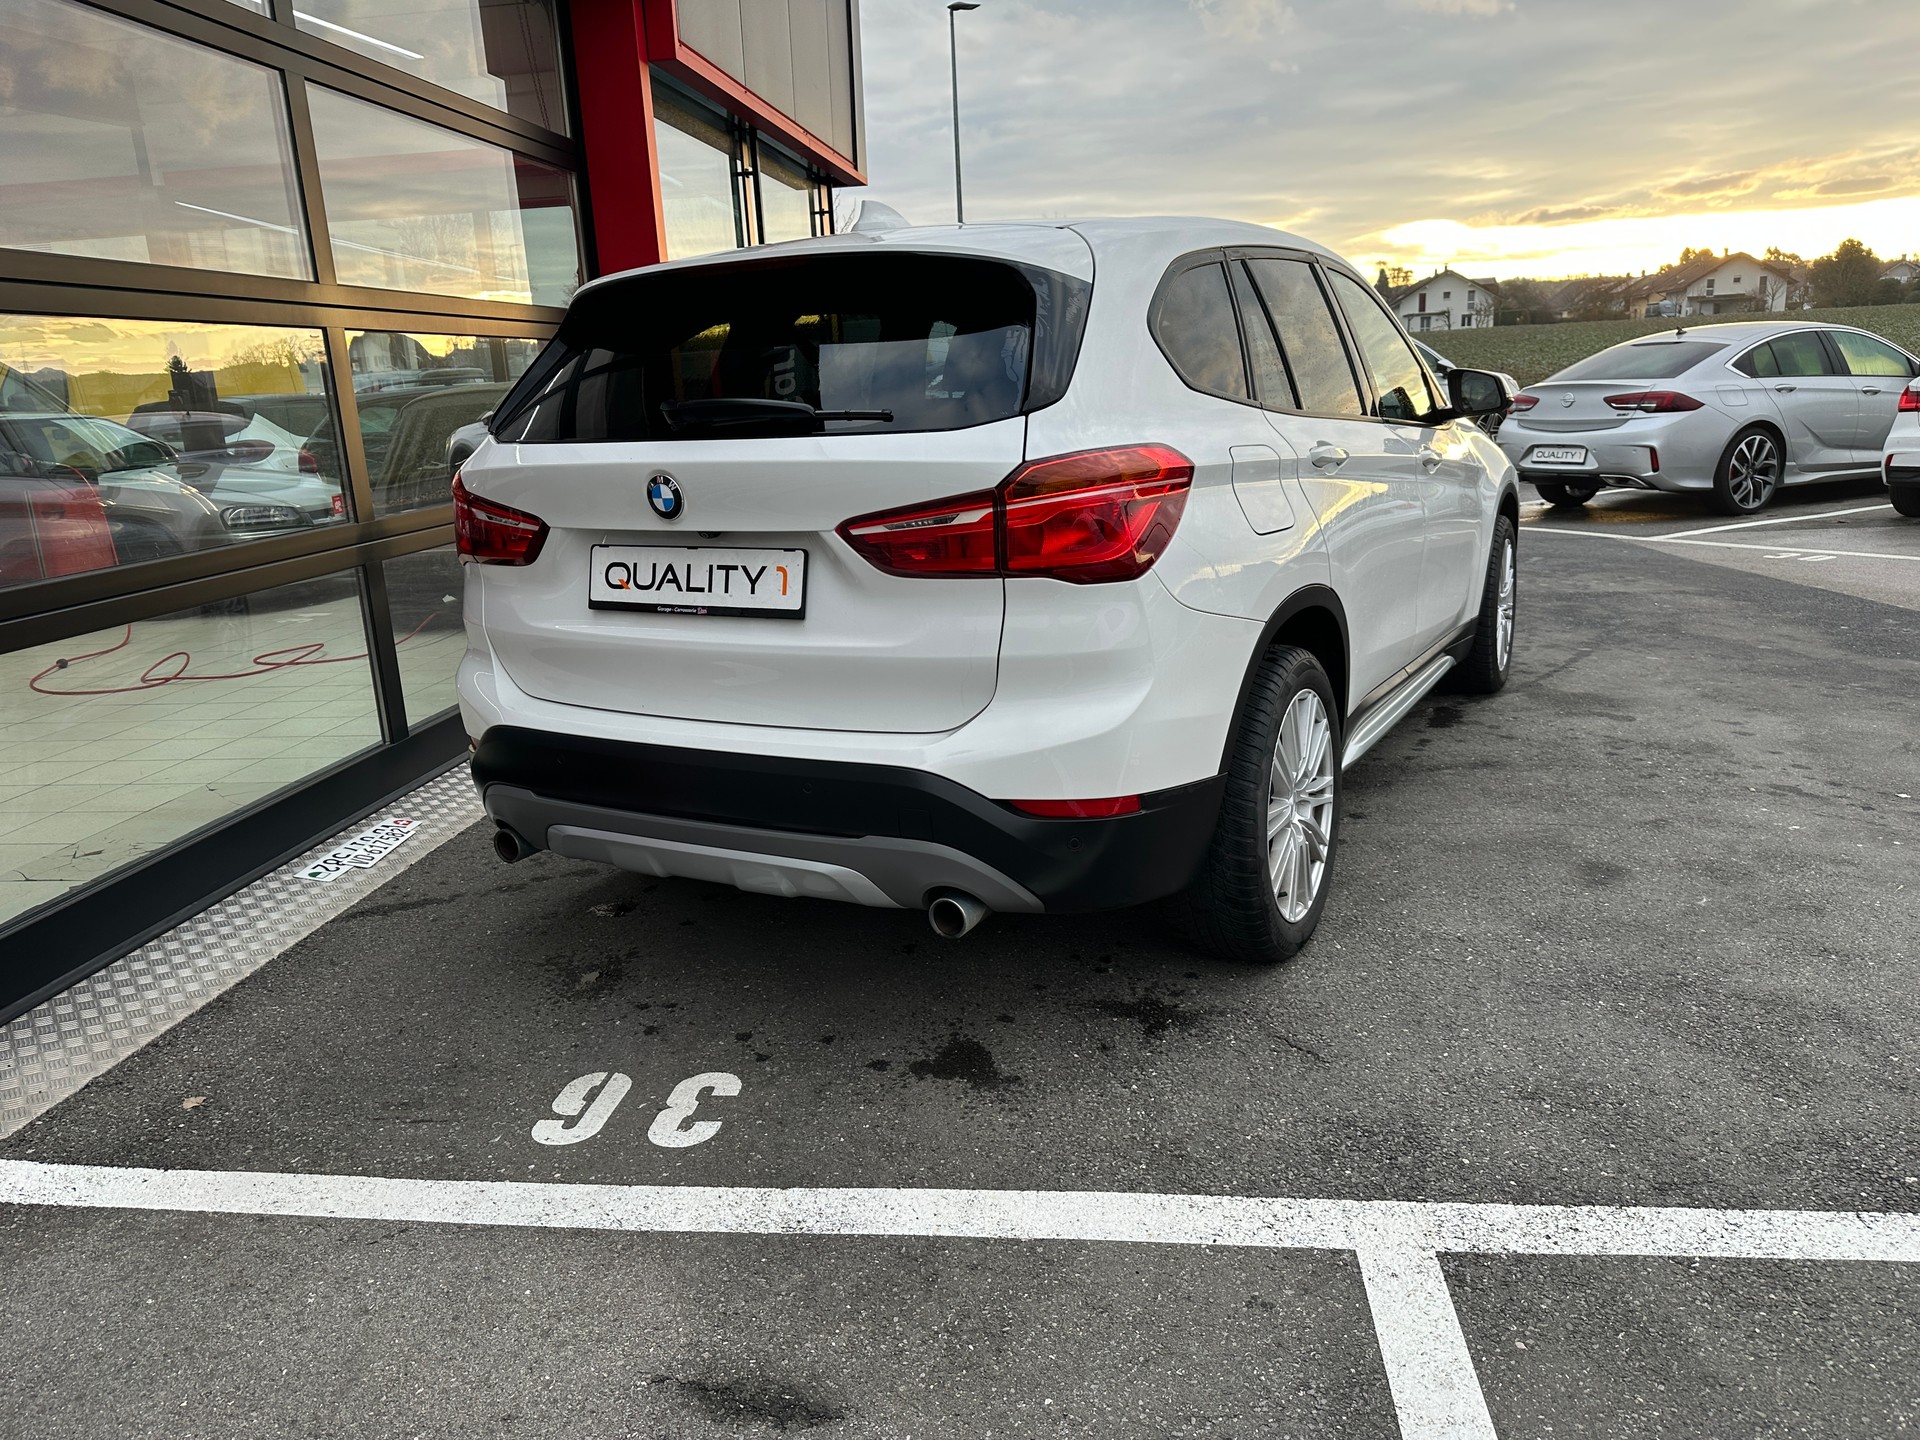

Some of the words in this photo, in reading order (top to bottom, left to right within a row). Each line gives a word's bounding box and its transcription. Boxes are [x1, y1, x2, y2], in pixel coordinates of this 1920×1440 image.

[1535, 450, 1577, 460] QUALITY
[604, 561, 768, 595] QUALITY
[776, 565, 788, 596] 1
